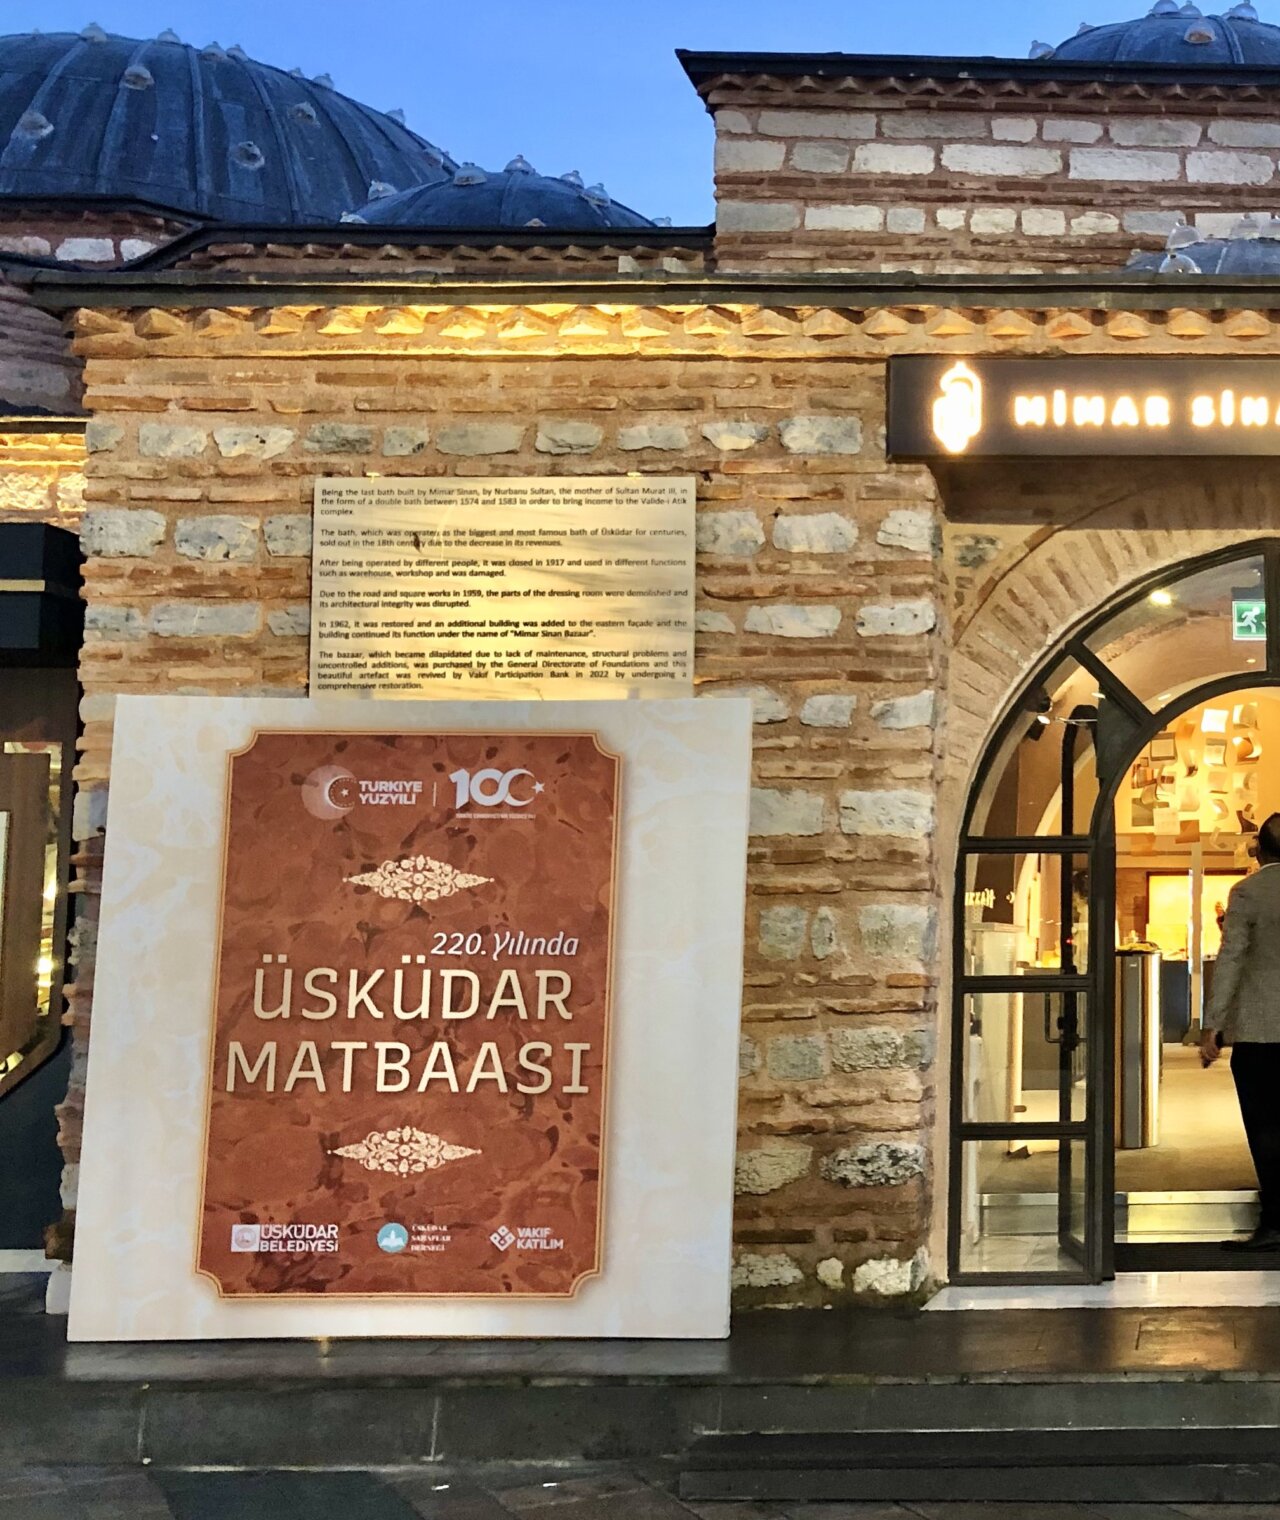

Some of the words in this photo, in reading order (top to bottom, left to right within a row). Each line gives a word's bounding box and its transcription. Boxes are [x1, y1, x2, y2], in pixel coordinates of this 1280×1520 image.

[1014, 389, 1170, 427] MİMAR
[468, 570, 507, 578] damaged.
[489, 620, 520, 628] building
[318, 631, 350, 639] building
[632, 650, 669, 658] problems
[477, 661, 486, 669] by
[431, 932, 487, 957] 220.
[492, 931, 580, 961] Yılında
[252, 954, 574, 1020] ÜSKÜDAR
[225, 1041, 592, 1094] MATBAASI
[517, 1227, 551, 1238] VAKIF
[517, 1239, 564, 1249] KATILIM
